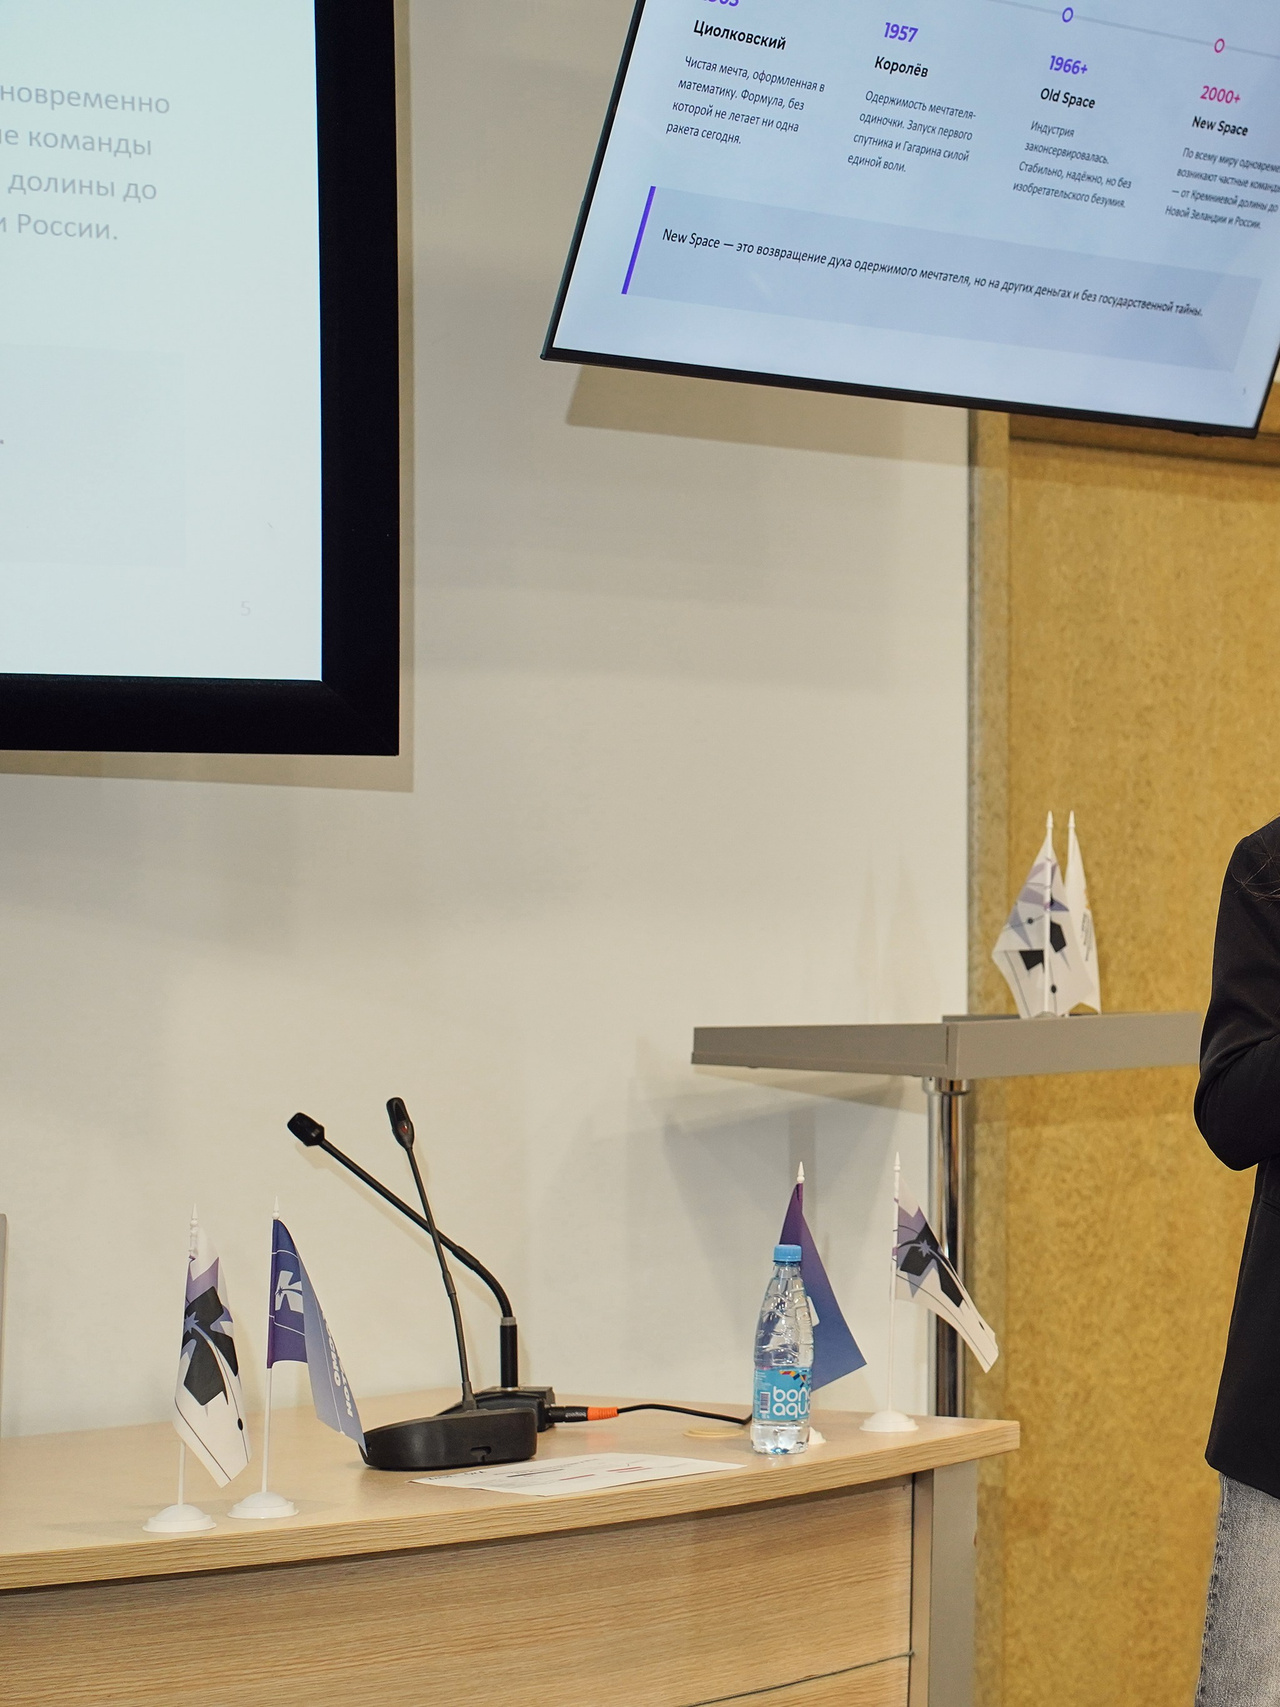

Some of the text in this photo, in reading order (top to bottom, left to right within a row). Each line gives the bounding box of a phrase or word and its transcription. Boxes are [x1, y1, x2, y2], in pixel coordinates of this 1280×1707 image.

[693, 19, 787, 50] Циолковский
[884, 22, 919, 43] 1957
[685, 55, 826, 93] Чистая мечта, оформленная в
[874, 55, 929, 78] Королёв
[1049, 55, 1088, 75] 1966+
[678, 79, 805, 111] математику. Формула, без
[865, 90, 977, 121] Одержимость мечтателя-
[1040, 87, 1096, 108] Old Space
[1200, 85, 1241, 104] 2000+
[672, 101, 800, 132] которой не летает ни одна
[859, 112, 973, 141] одиночки. Запуск первого
[1192, 115, 1249, 137] New Space
[666, 122, 742, 144] ракета сегодня.
[1030, 120, 1075, 138] Индустрия
[29, 130, 152, 158] команды
[853, 133, 970, 162] спутника и Гагарина силой
[1024, 142, 1109, 165] законсервировалась.
[847, 154, 907, 173] единой воли.
[1182, 147, 1194, 159] По
[1194, 150, 1218, 165] всему
[1219, 155, 1240, 168] миру
[1019, 161, 1064, 180] Стабильно,
[1105, 177, 1116, 188] но
[1117, 176, 1132, 190] без
[8, 174, 157, 203] долины до
[1013, 182, 1090, 203] изобретательского
[1181, 189, 1190, 199] от
[1165, 205, 1190, 219] Новой
[18, 213, 118, 240] России.
[662, 228, 688, 244] New
[688, 232, 721, 249] Space
[736, 242, 755, 254] это
[756, 245, 827, 262] возвращение
[827, 255, 852, 270] духа
[854, 259, 918, 278] одержимого
[919, 269, 972, 287] мечтателя,
[974, 276, 986, 288] но
[988, 280, 1000, 290] на
[1000, 281, 1034, 295] других
[1034, 285, 1072, 299] деньгах
[1081, 289, 1098, 303] без
[1098, 294, 1174, 311] государственной
[773, 1386, 810, 1402] bon
[772, 1402, 810, 1418] aqu
